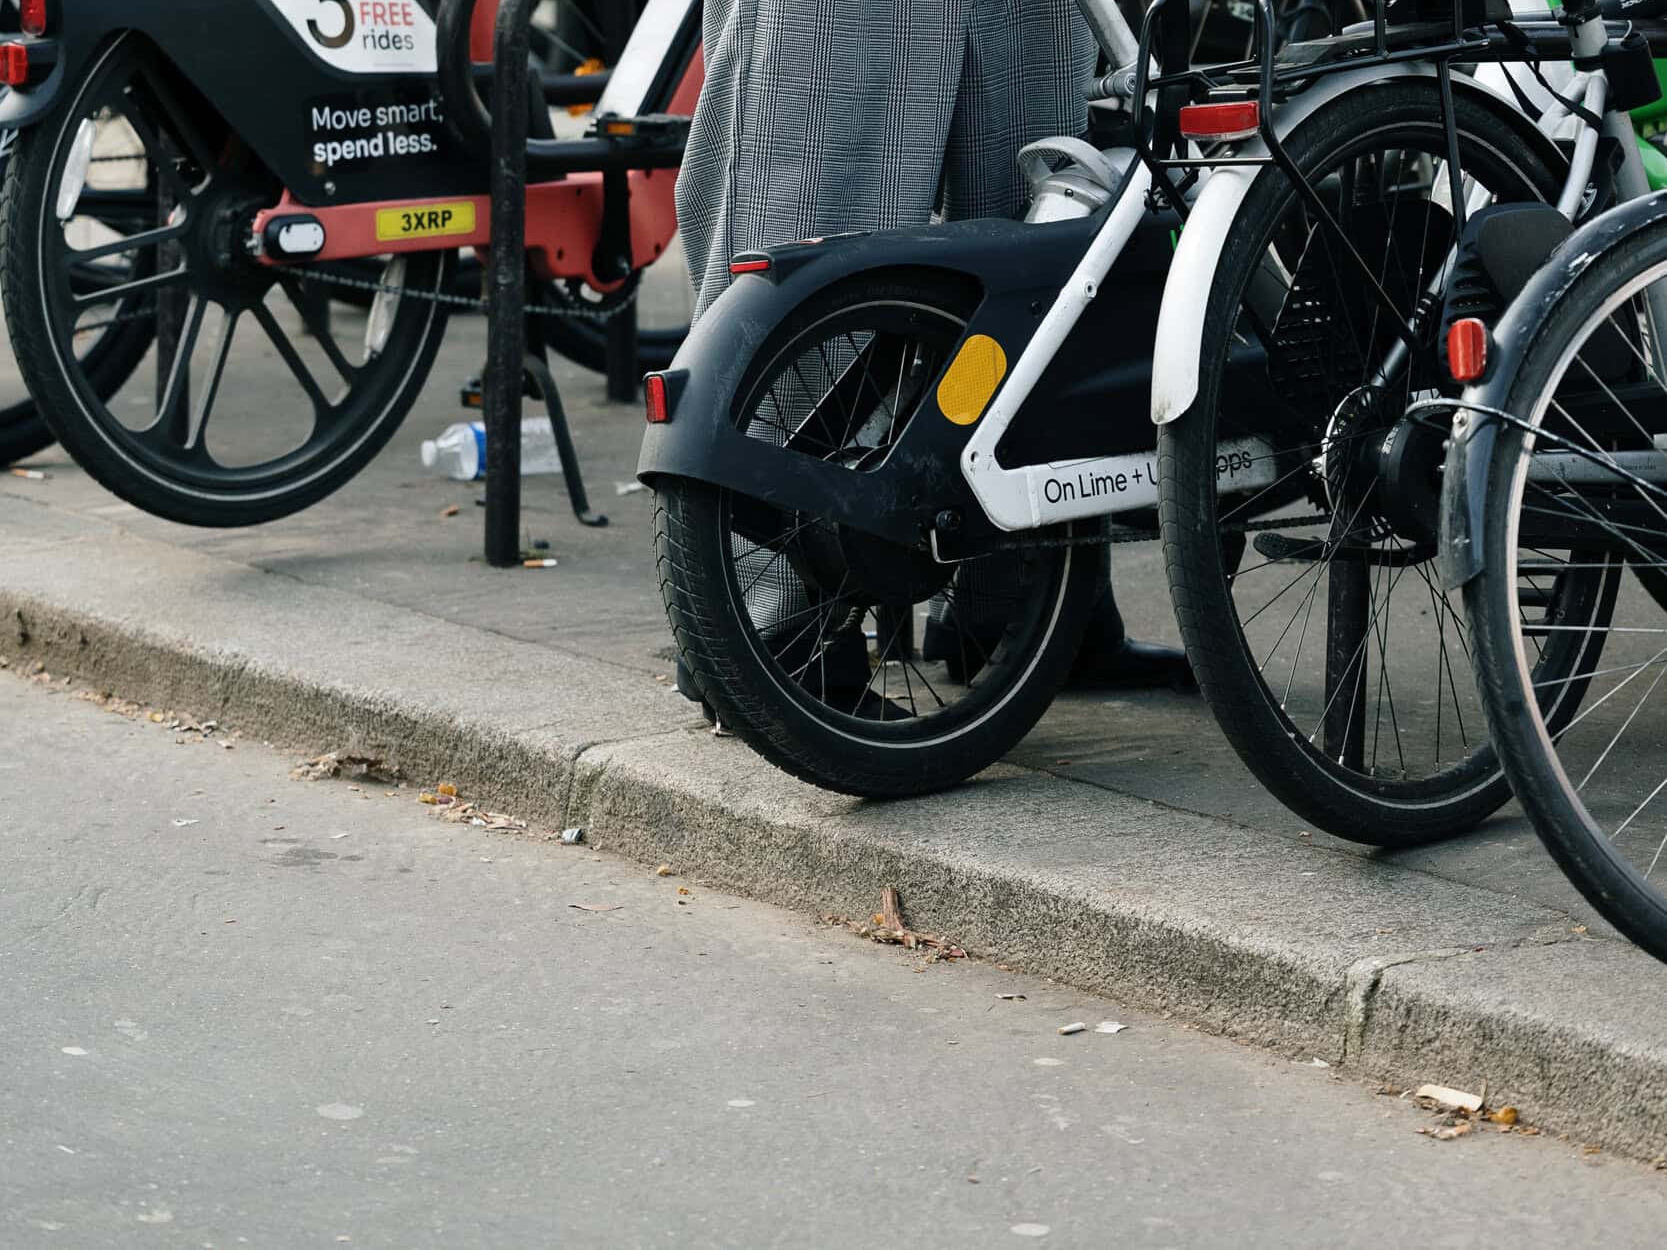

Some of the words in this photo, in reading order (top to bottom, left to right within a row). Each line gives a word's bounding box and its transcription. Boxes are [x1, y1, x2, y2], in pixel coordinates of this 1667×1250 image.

[359, 1, 415, 27] FREE
[362, 29, 415, 51] rides
[312, 106, 372, 131] Move
[375, 99, 444, 126] smart,
[313, 132, 385, 167] spend
[386, 131, 438, 156] less.
[401, 210, 453, 232] 3XRP
[1044, 478, 1076, 504] On
[1078, 472, 1128, 499] Lime
[1215, 451, 1252, 481] pps
